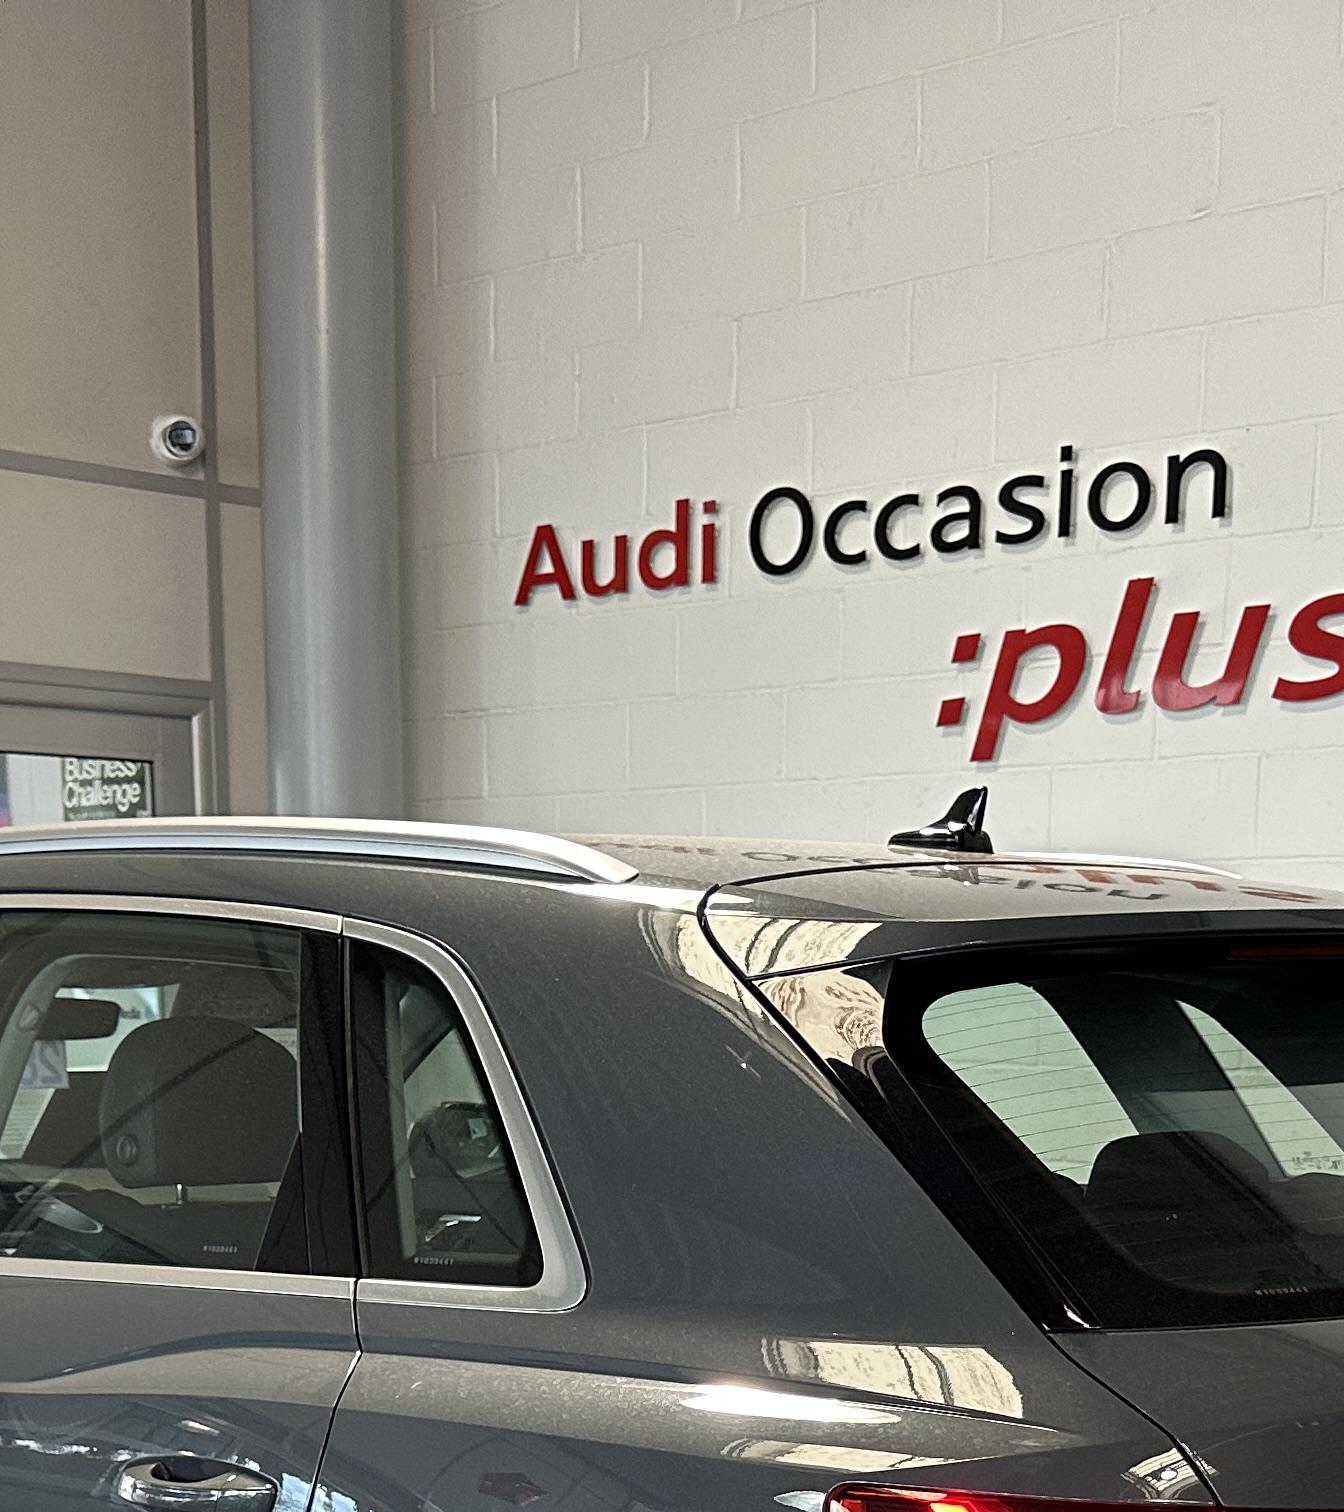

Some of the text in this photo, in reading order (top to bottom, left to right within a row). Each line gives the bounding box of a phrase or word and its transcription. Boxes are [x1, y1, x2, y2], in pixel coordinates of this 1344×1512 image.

[513, 443, 1230, 606] Audi Occasion
[64, 758, 138, 781] Business
[64, 780, 141, 812] Challenge
